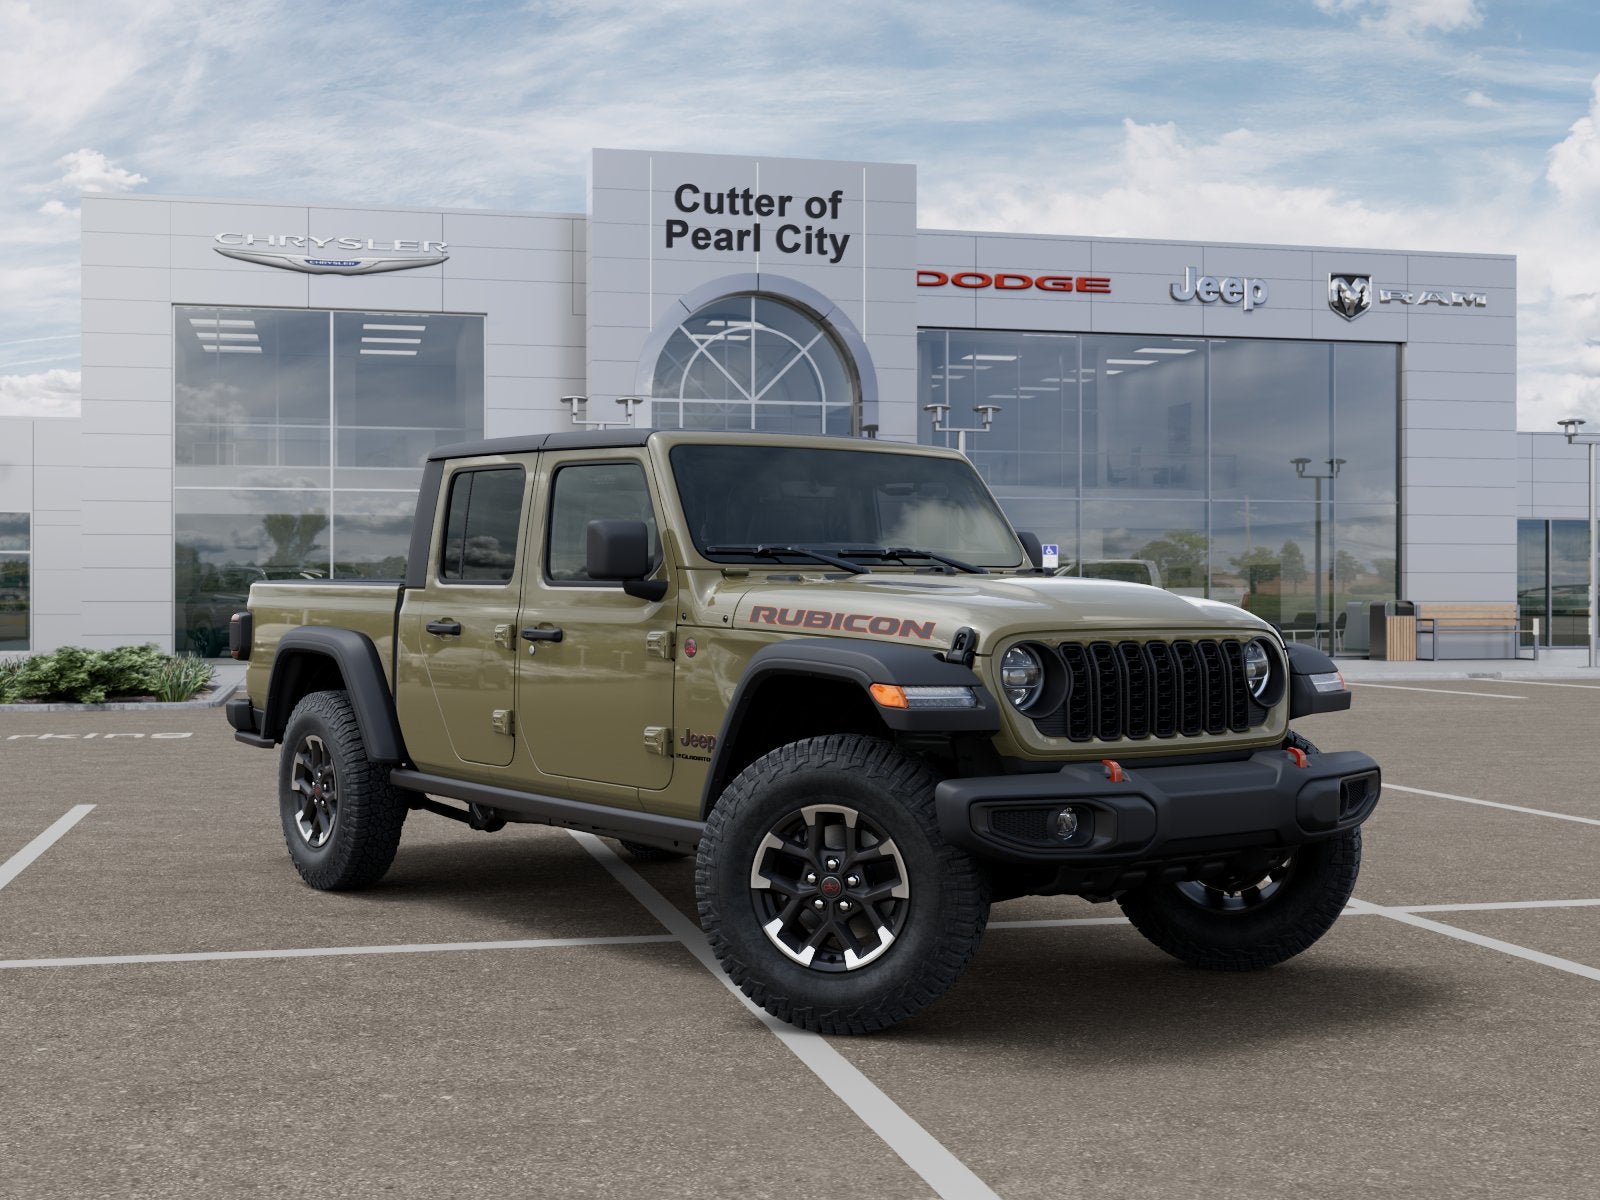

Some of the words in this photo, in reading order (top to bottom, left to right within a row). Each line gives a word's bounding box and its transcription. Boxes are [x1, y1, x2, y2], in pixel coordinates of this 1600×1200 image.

[674, 183, 793, 217] Cutter
[804, 190, 844, 220] of
[214, 232, 448, 253] CHRYSLER
[665, 219, 761, 252] Pearl
[775, 224, 851, 264] City
[917, 270, 1111, 293] DODGE
[1170, 266, 1268, 311] Jeep
[1379, 289, 1487, 307] RAM
[750, 605, 936, 639] RUBICON
[680, 727, 717, 753] Jeep
